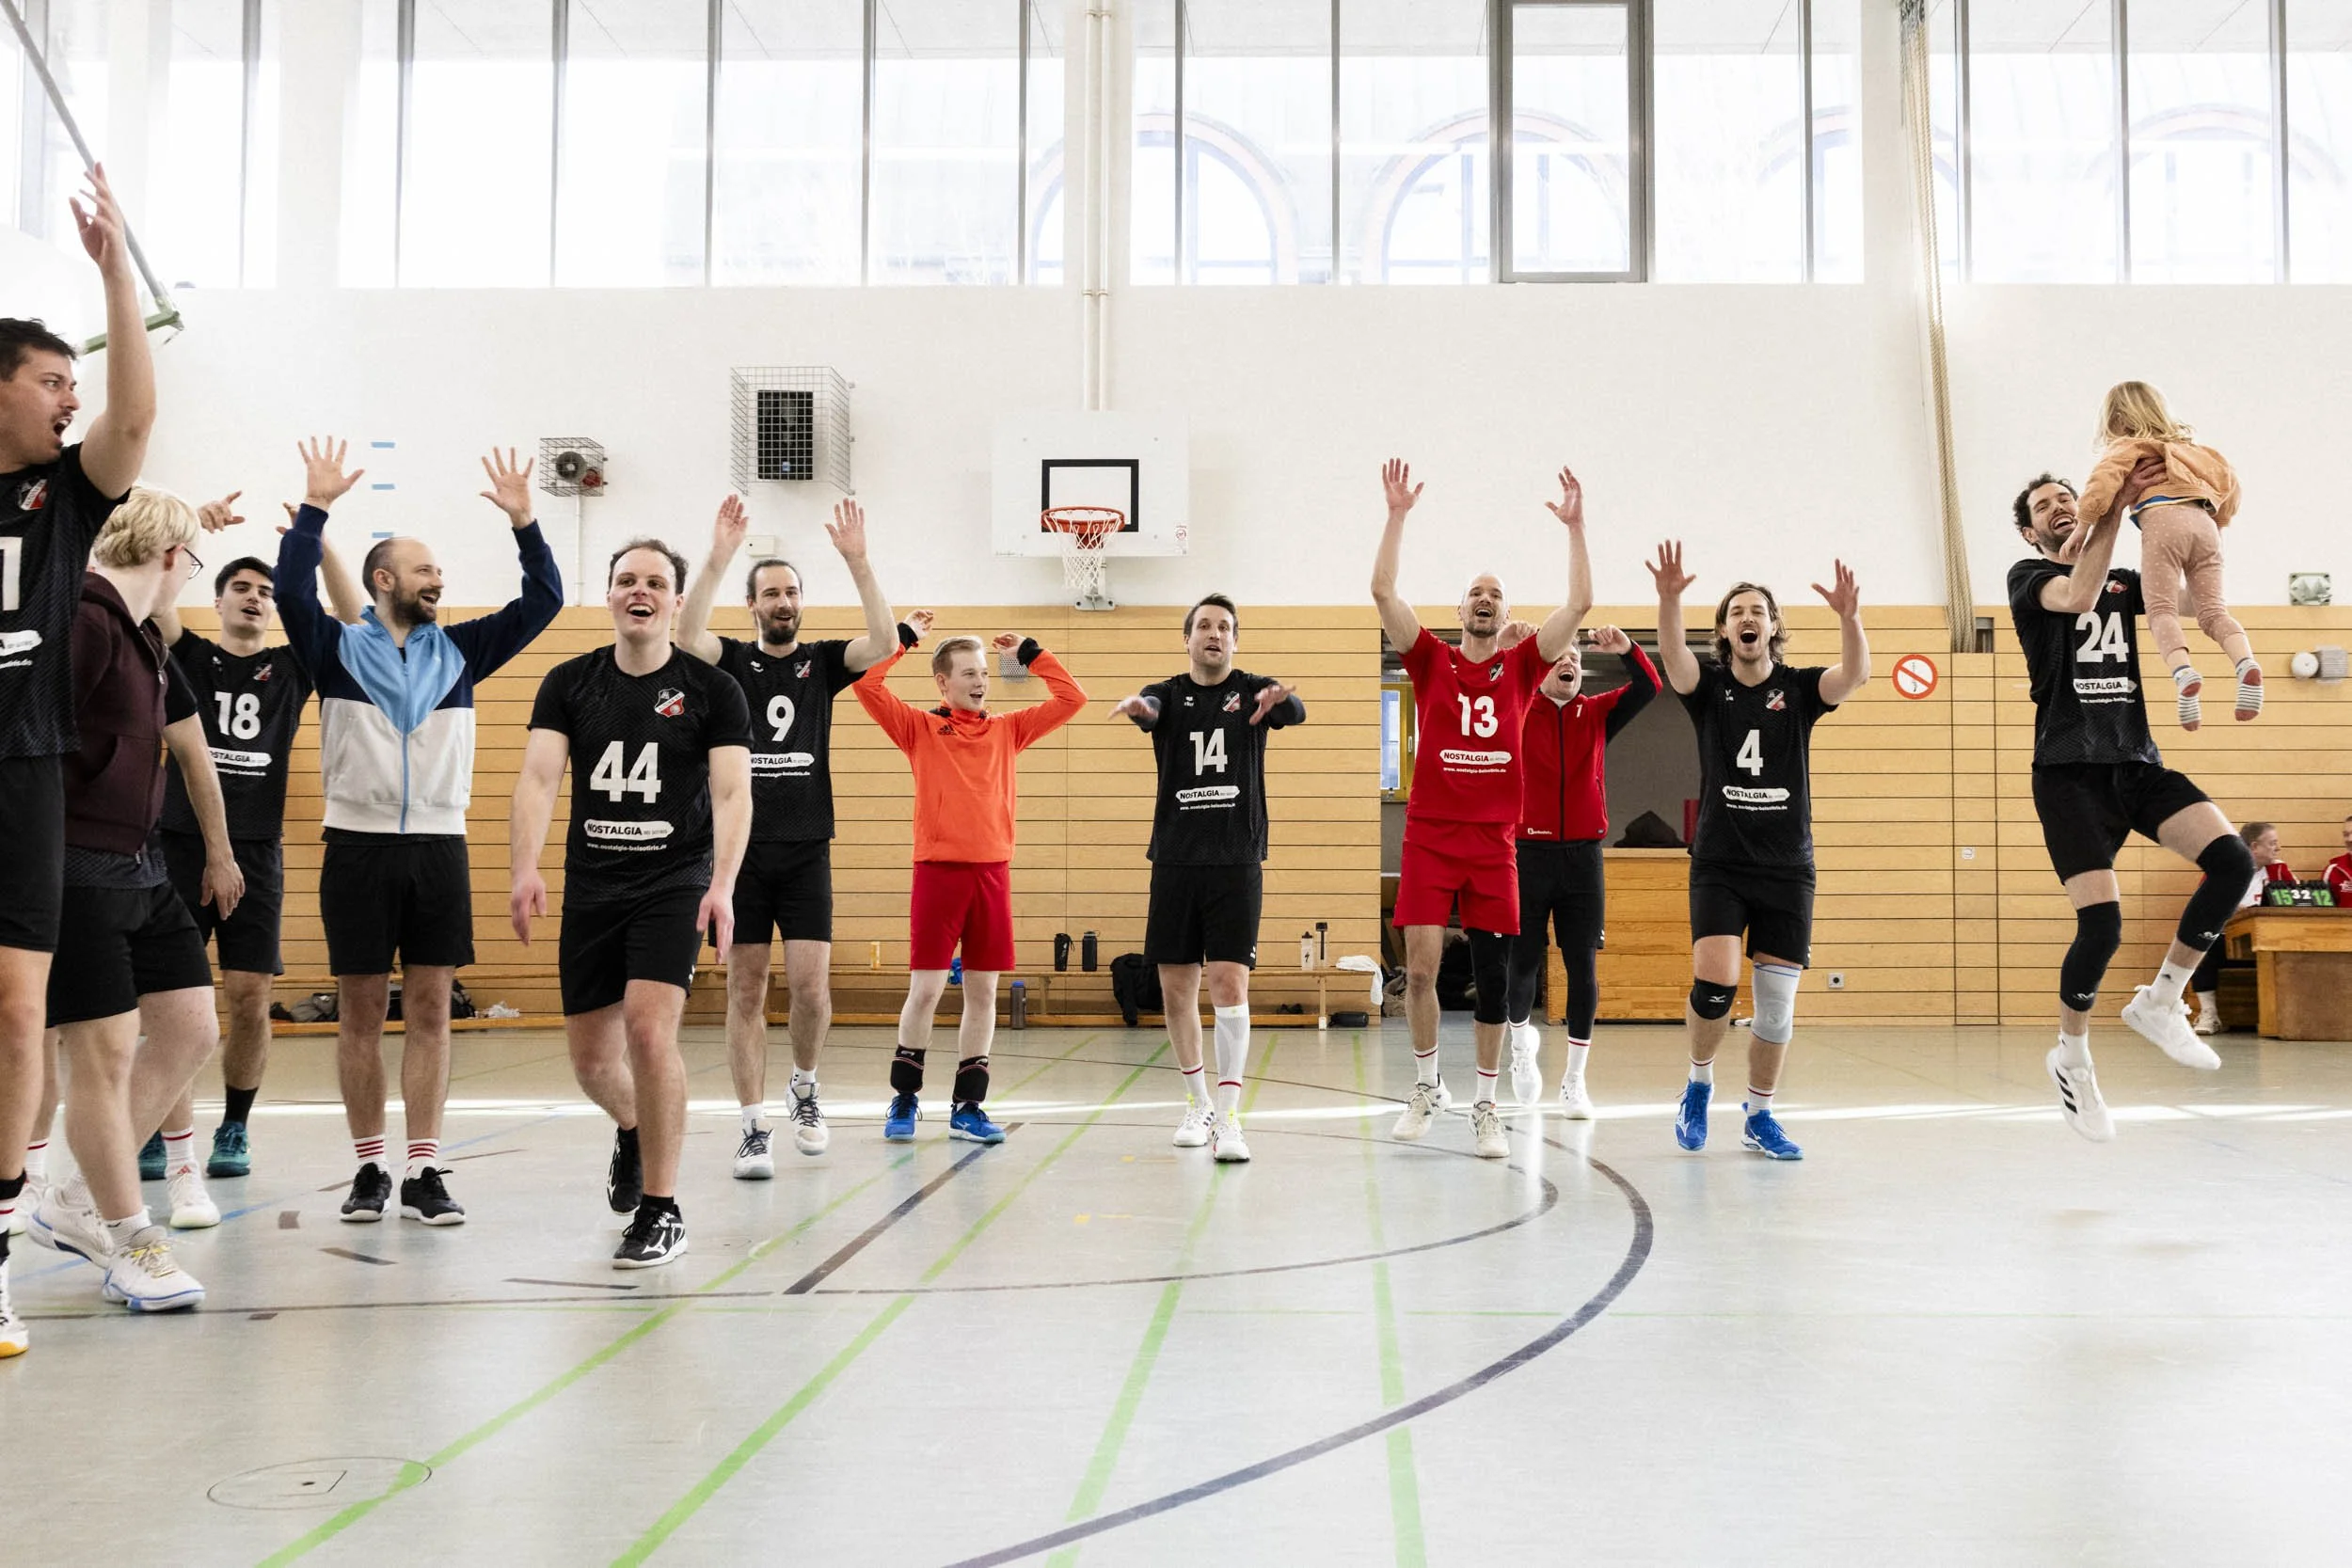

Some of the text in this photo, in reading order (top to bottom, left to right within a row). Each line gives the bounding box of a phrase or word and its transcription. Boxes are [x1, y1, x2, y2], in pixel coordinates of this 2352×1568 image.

[2074, 611, 2130, 662] 24
[215, 690, 261, 740] 18
[766, 695, 795, 741] 9
[1457, 692, 1498, 737] 13
[590, 740, 661, 803] 44
[1189, 728, 1228, 775] 14
[1443, 752, 1489, 762] NOSTALGIA
[1736, 729, 1764, 776] 4
[1180, 790, 1219, 800] NOSTALGIA
[1726, 788, 1768, 799] NOSTALGIA
[587, 824, 643, 836] NOSTALGIA
[2272, 889, 2294, 906] 15
[2312, 889, 2334, 906] 12
